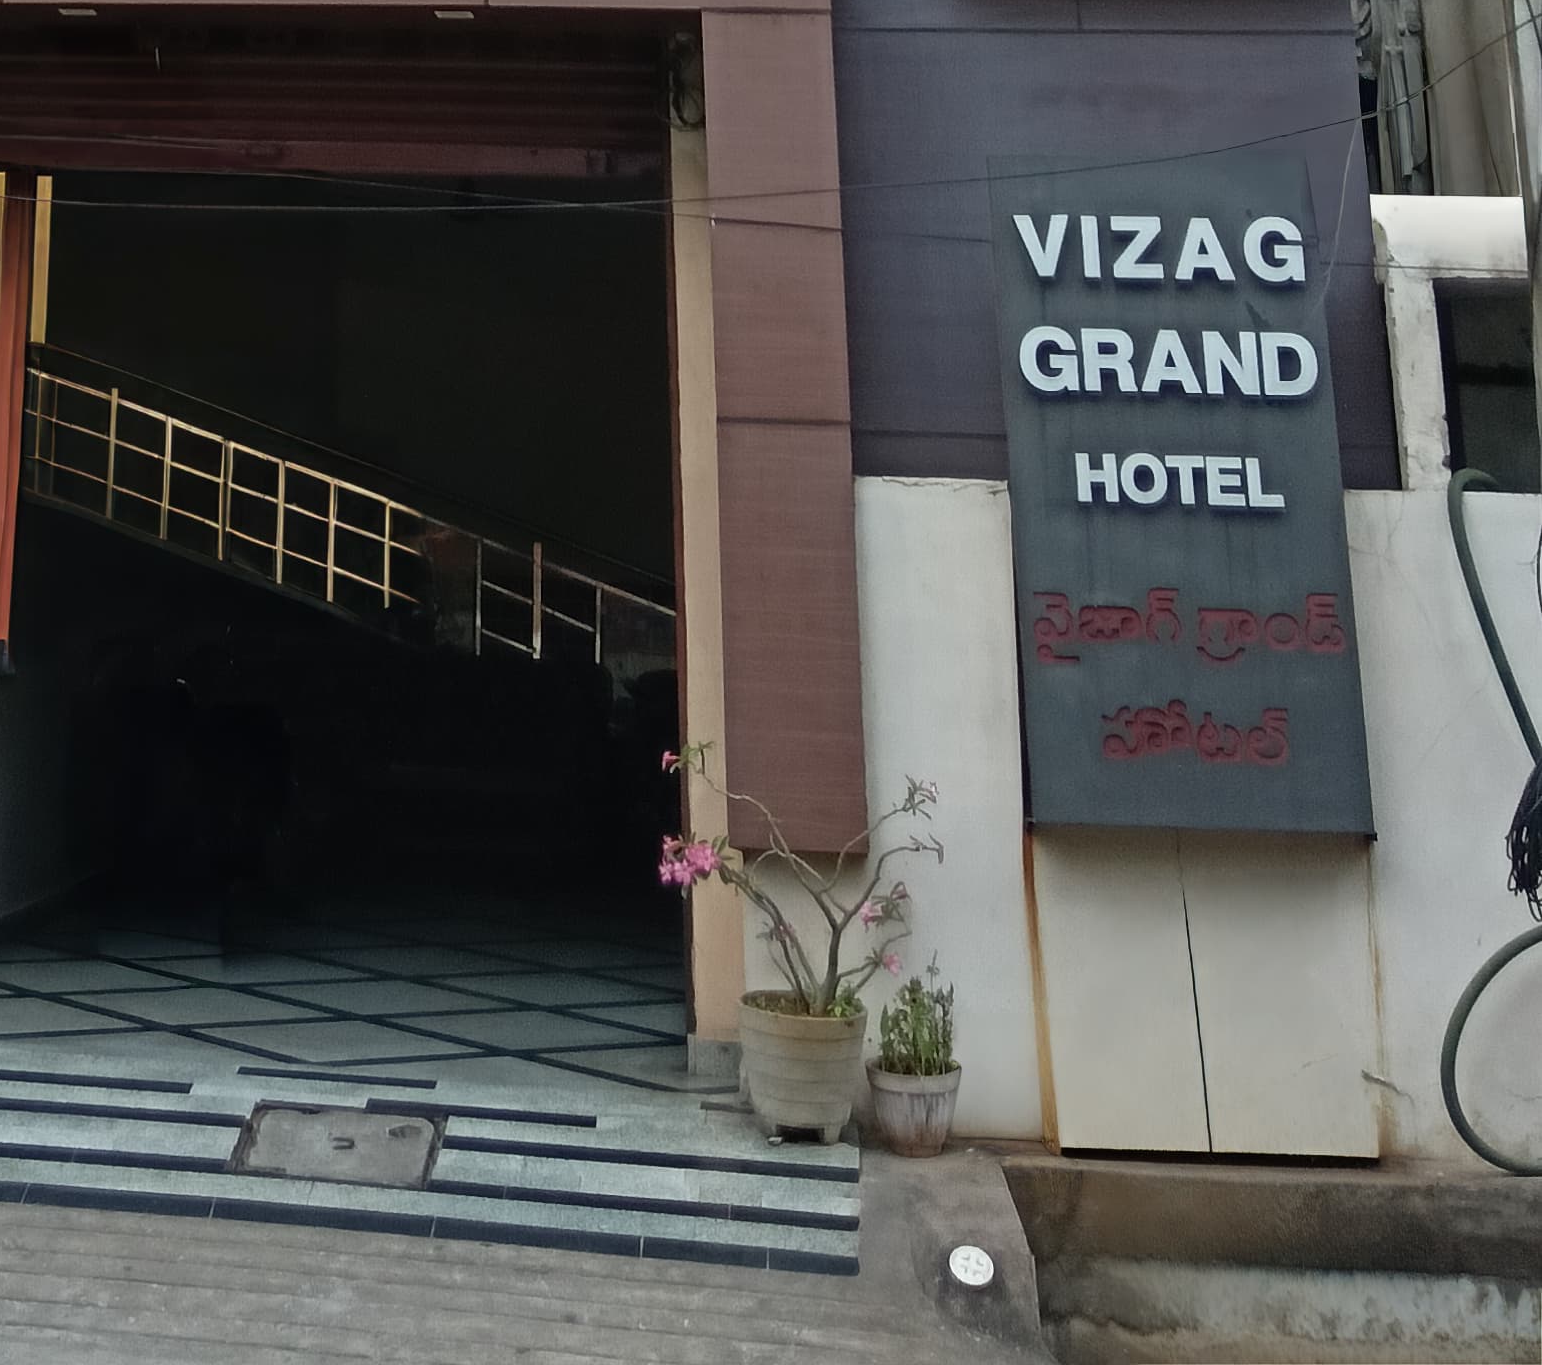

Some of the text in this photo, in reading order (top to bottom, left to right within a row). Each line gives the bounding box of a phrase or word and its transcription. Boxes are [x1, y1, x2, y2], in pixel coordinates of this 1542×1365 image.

[1013, 214, 1306, 282] VIZAG
[1019, 326, 1318, 396] GRAND
[1075, 452, 1285, 508] HOTEL
[1033, 587, 1346, 663] వైజాగ్ గ్రాండ్
[1101, 698, 1290, 763] హోటల్
